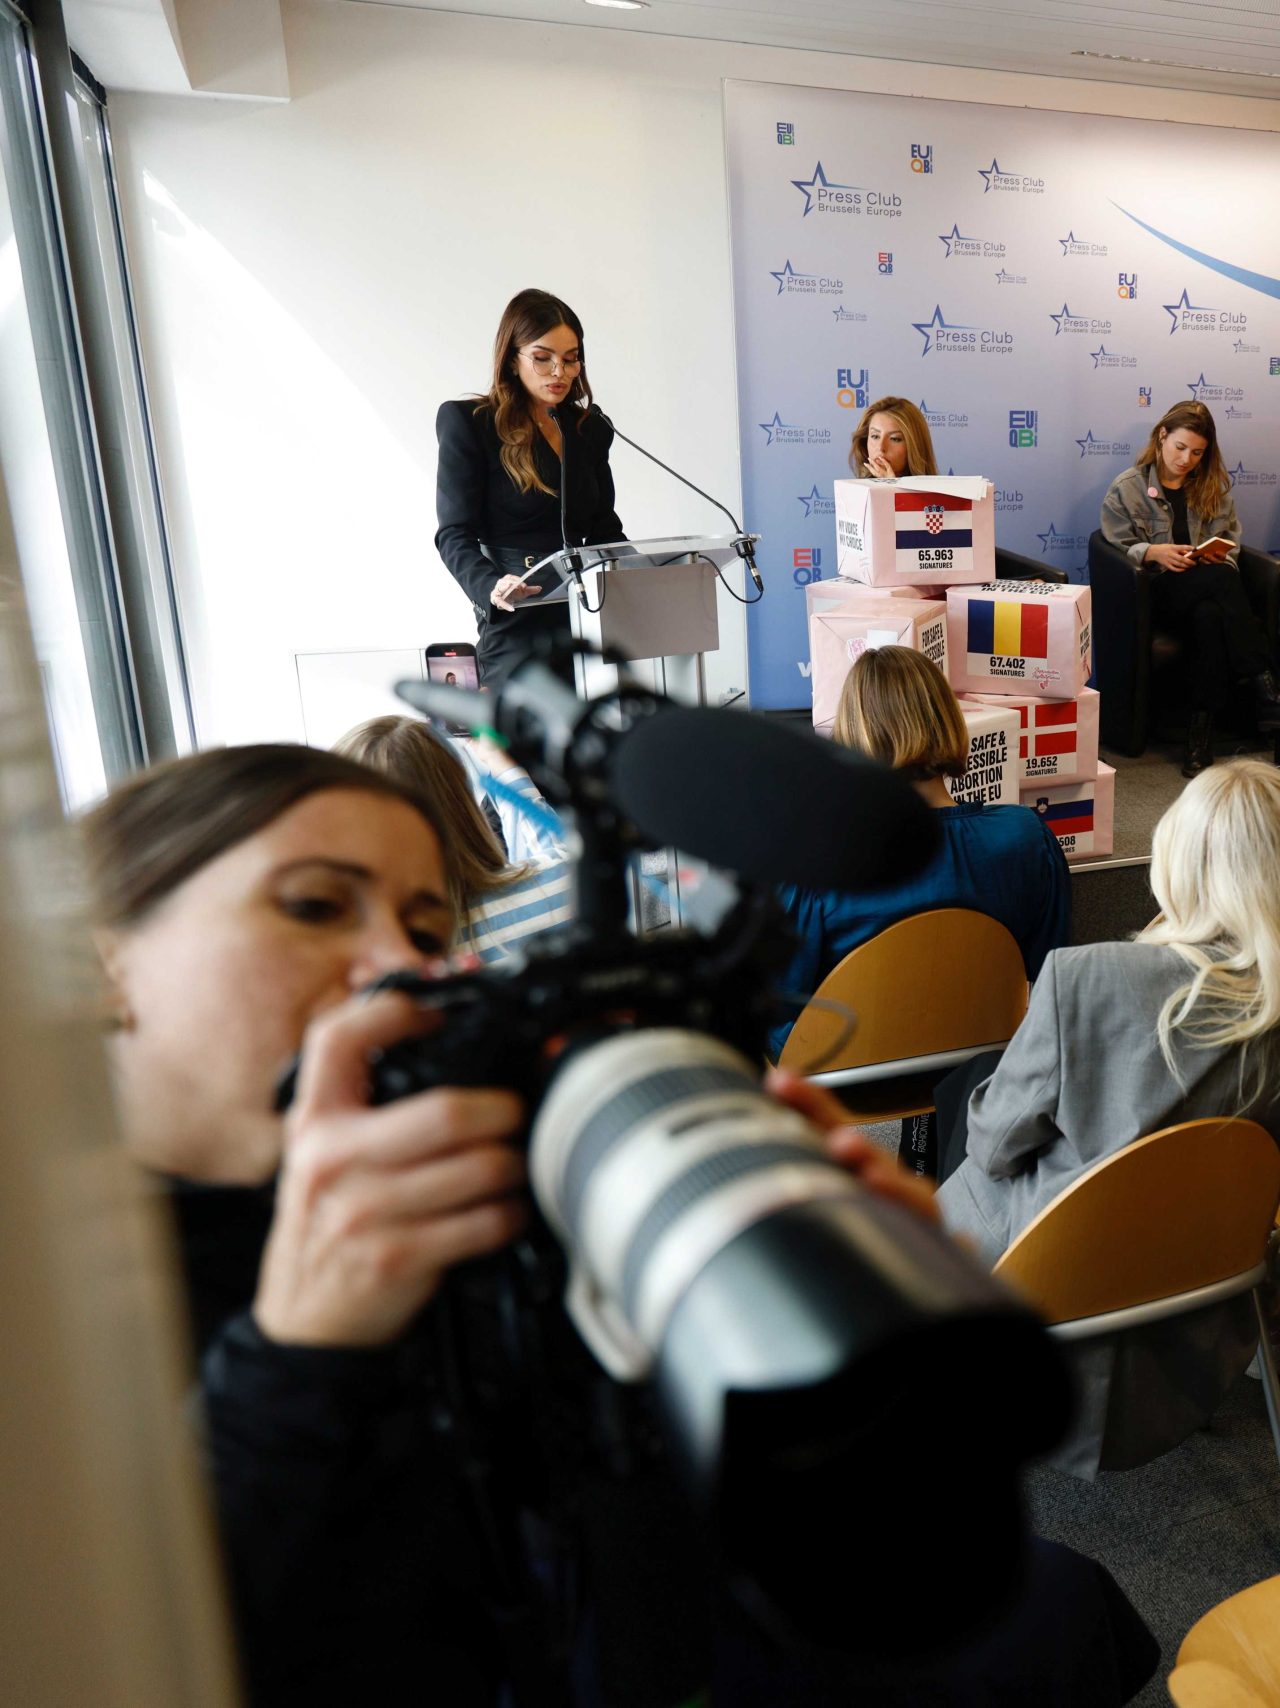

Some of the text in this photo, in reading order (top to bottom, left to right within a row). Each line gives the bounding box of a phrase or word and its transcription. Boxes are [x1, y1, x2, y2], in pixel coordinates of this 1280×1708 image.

[777, 122, 792, 134] EU
[911, 144, 929, 158] EU
[911, 159, 929, 174] QB
[994, 176, 1044, 187] Press Club
[1023, 186, 1044, 194] Europe
[818, 189, 902, 207] Press Club
[818, 203, 902, 218] Brussels Europe
[954, 240, 1006, 251] Press Club
[1091, 244, 1108, 252] Club
[879, 252, 892, 262] EU
[787, 276, 843, 288] Press Club
[1119, 273, 1134, 286] EU
[1118, 286, 1134, 299] QB
[1064, 318, 1111, 328] Press Club
[1182, 311, 1247, 323] Press Club
[1182, 323, 1246, 333] Brussels Europe
[936, 330, 1013, 344] Press Club
[937, 343, 1013, 355] Brussels Europe
[838, 369, 865, 388] EU
[1139, 387, 1151, 396] EU
[837, 389, 865, 408] QB
[948, 413, 968, 421] Club
[1010, 411, 1034, 429] EU
[776, 429, 831, 437] Press Club
[1010, 429, 1033, 448] QB
[993, 490, 1023, 502] Club
[814, 500, 836, 508] Pres
[845, 521, 858, 536] VOICE
[846, 536, 862, 551] CHOICE
[794, 548, 821, 567] EU
[918, 550, 953, 561] 65.963
[922, 630, 930, 648] FOR
[930, 623, 940, 643] SAFE
[990, 657, 1025, 669] 67.402
[990, 668, 1025, 677] SIGNATURES
[970, 731, 1006, 752] SAFE &
[967, 747, 1007, 771] ESSIBLE
[1026, 756, 1058, 769] 19.652
[1026, 768, 1057, 776] SIGNATURES
[950, 765, 1002, 794] ABORTION
[966, 789, 986, 803] THE
[989, 784, 1001, 801] EU
[1059, 836, 1076, 846] 508
